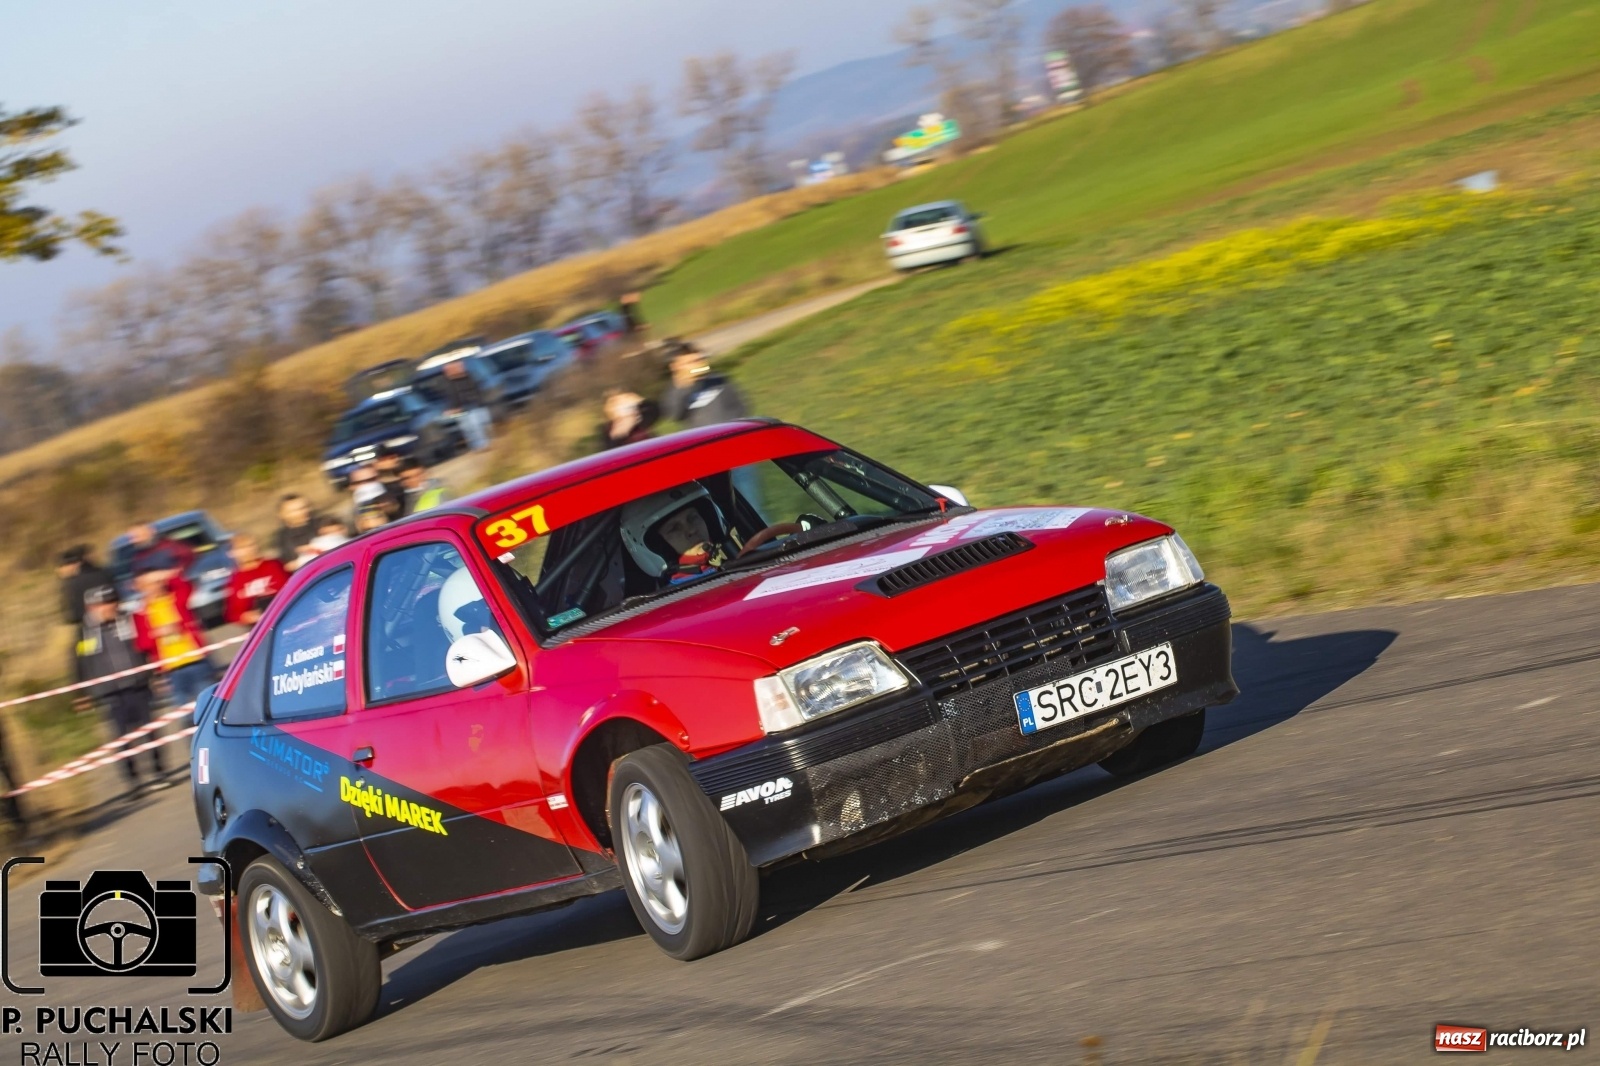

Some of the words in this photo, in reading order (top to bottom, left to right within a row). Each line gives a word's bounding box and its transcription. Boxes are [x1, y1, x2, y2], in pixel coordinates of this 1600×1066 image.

[485, 504, 550, 548] 37
[1037, 677, 1099, 722] SRC
[1105, 650, 1172, 700] 2EY3
[1022, 717, 1035, 728] PL
[340, 776, 383, 817] Dzięki
[385, 794, 448, 836] MAREK
